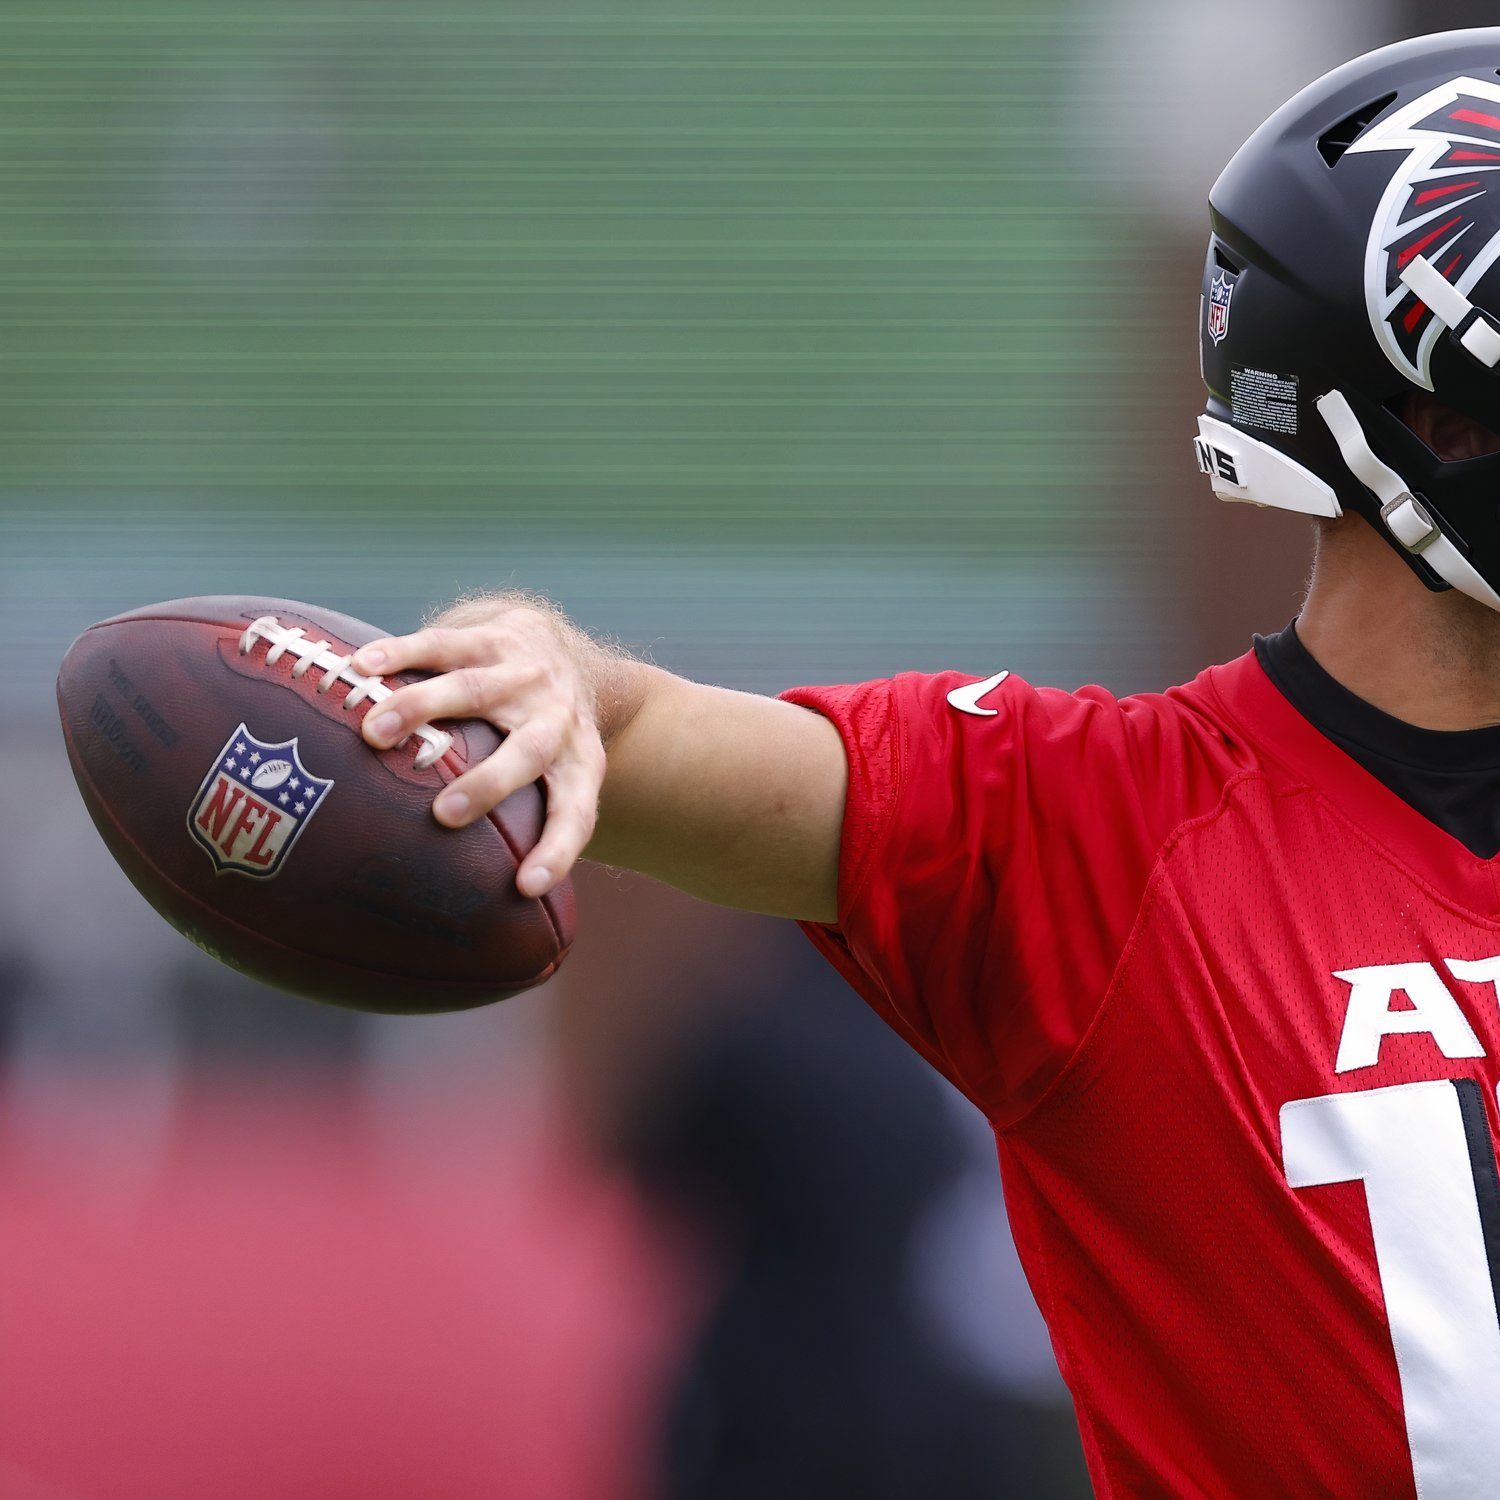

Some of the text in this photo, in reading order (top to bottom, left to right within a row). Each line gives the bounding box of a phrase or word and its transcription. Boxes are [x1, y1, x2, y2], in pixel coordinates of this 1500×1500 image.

[1209, 303, 1225, 331] NFL
[1244, 367, 1278, 379] WARNING
[1195, 438, 1239, 485] NS
[197, 777, 282, 866] NFL
